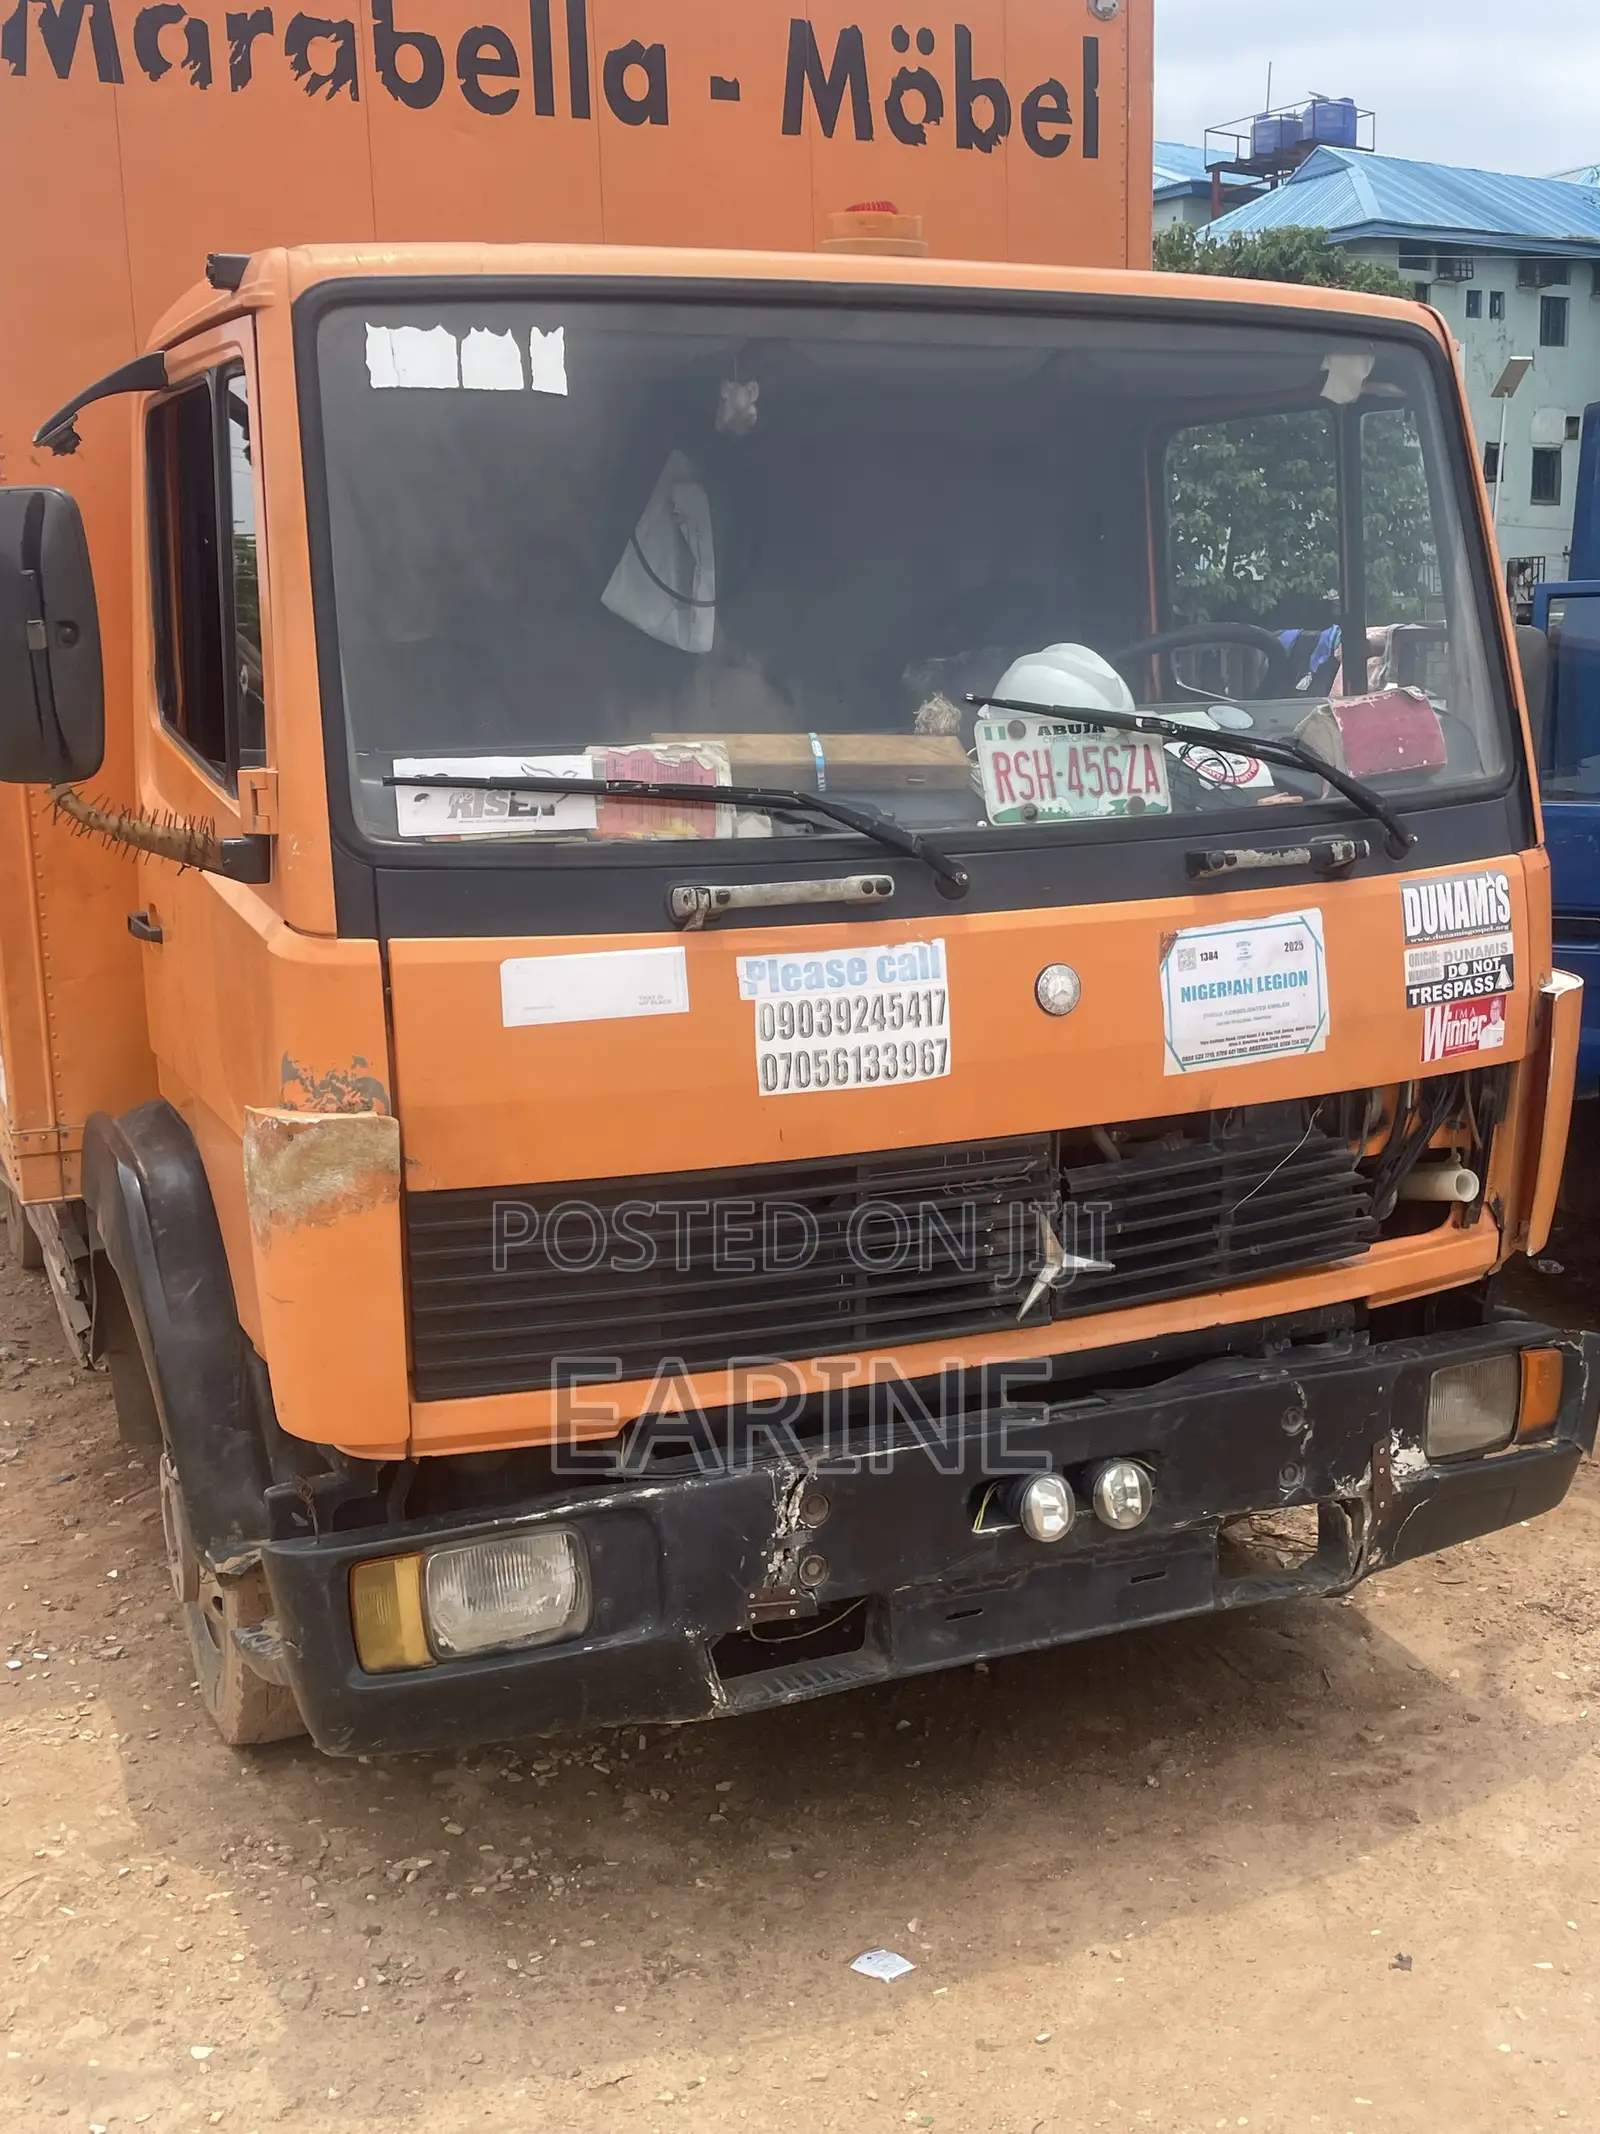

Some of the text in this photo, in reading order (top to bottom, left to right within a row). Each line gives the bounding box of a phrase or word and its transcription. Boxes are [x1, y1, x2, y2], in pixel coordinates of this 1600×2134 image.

[0, 0, 669, 127] Marabella
[781, 17, 1100, 160] Möbel
[1037, 723, 1106, 737] ABUJA
[1200, 950, 1219, 962] 1384
[1284, 940, 1304, 953] 2025
[1443, 941, 1508, 963] DUNAMIS
[745, 945, 942, 996] Please call
[1448, 956, 1502, 979] DO NOT
[1180, 970, 1309, 1004] NIGERIAN LEGION
[1408, 975, 1494, 1006] TRESPASS
[759, 988, 946, 1042] 09039245417
[1423, 1004, 1488, 1062] Winner
[759, 1038, 948, 1092] 07056133967
